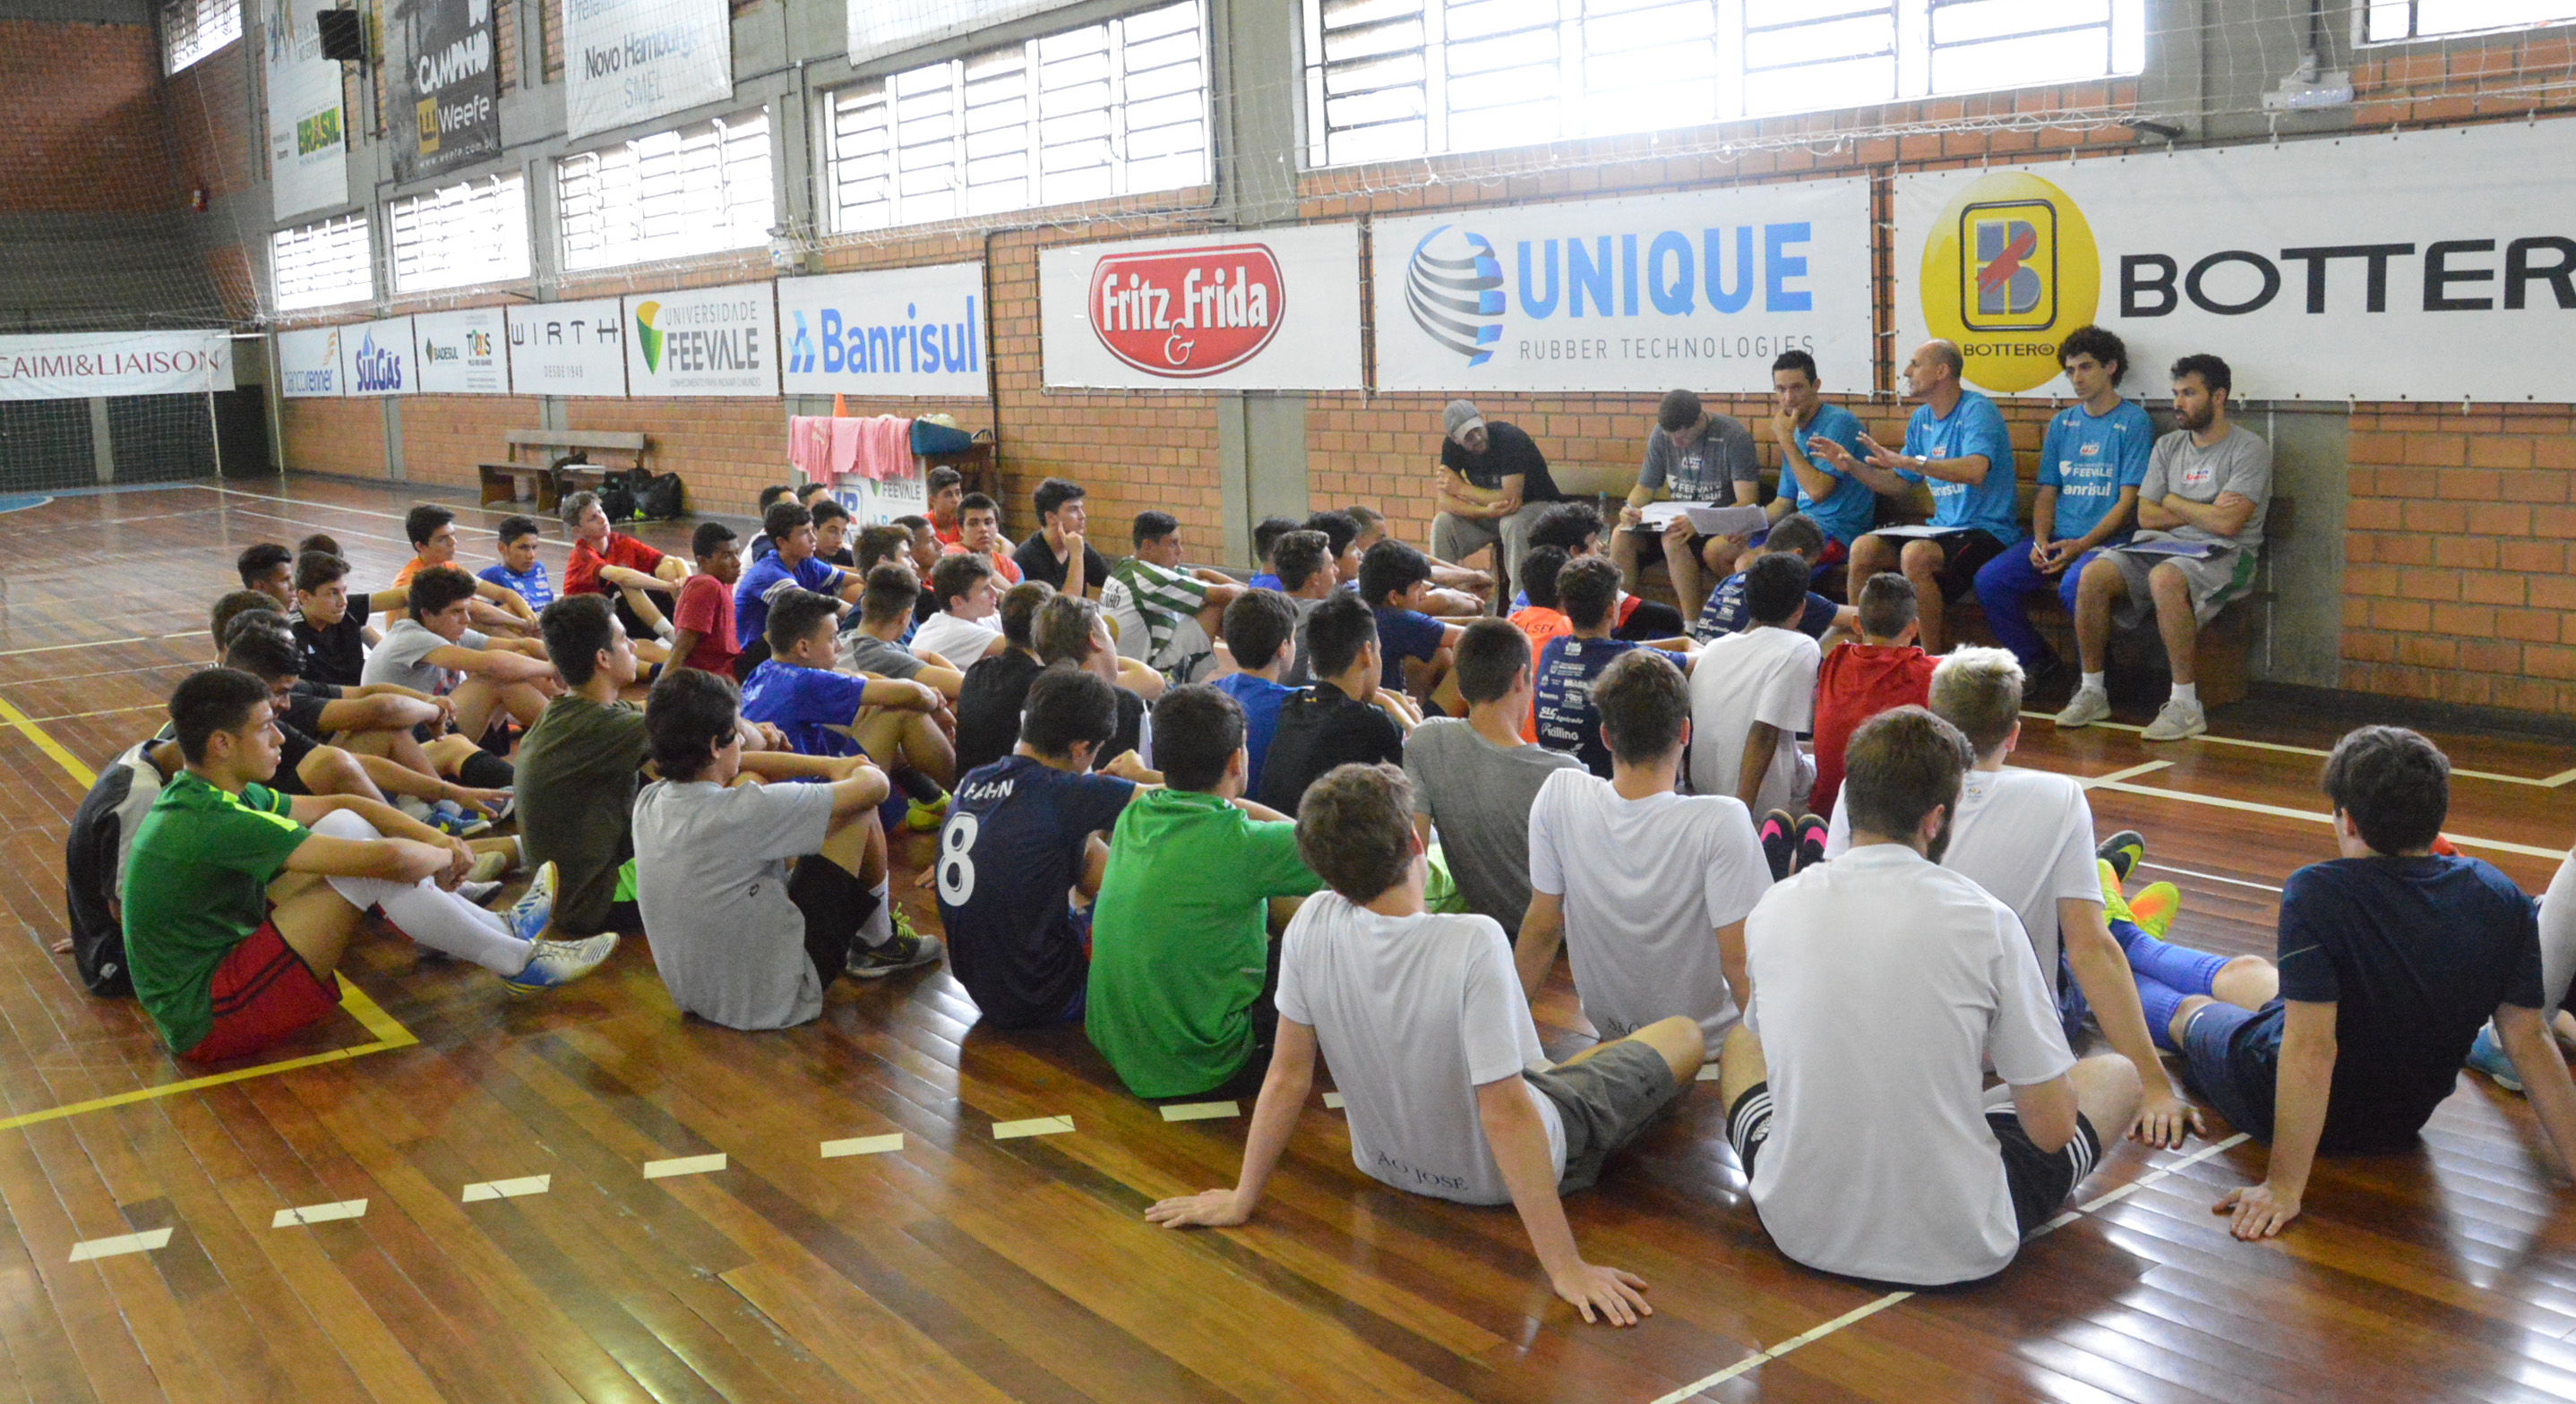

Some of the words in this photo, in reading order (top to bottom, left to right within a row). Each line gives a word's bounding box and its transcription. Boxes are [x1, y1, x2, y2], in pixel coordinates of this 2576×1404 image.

[585, 46, 620, 81] Novo
[624, 70, 665, 108] SMEL
[439, 94, 490, 134] Weefe
[1517, 222, 1813, 320] UNIQUE
[2119, 236, 2576, 317] BOTTER
[665, 301, 757, 326] UNIVERSIDADE
[1103, 273, 1171, 331] Fritz
[1183, 267, 1268, 330] Frida
[511, 318, 618, 346] WIRTH
[667, 328, 760, 372] FEEVALE
[820, 295, 978, 373] Banrisul
[1520, 339, 1608, 359] RUBBER
[1620, 336, 1814, 358] TECHNOLOGIES
[544, 365, 565, 378] DESDE
[882, 482, 922, 501] FEEVALE
[2063, 482, 2111, 497] anrisul
[938, 811, 978, 907] 8
